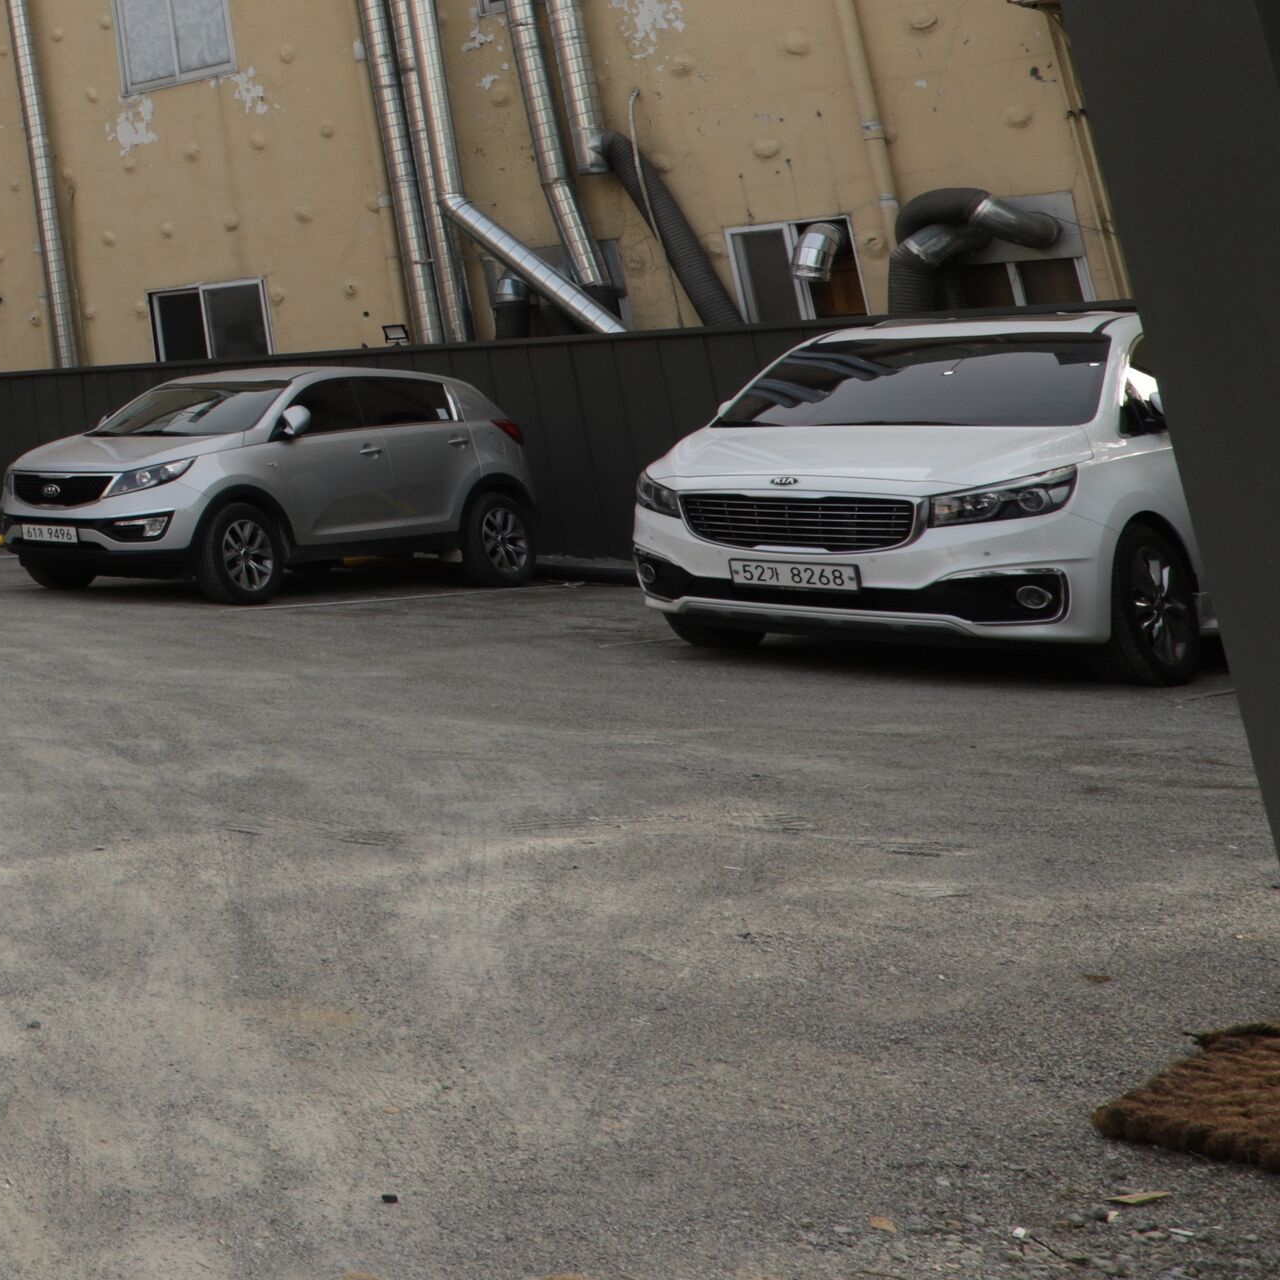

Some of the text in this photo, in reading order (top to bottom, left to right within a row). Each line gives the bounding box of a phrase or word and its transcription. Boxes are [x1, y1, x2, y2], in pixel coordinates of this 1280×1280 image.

[772, 476, 796, 485] KIA
[47, 527, 73, 540] 9496
[742, 563, 845, 587] 52가 8268
